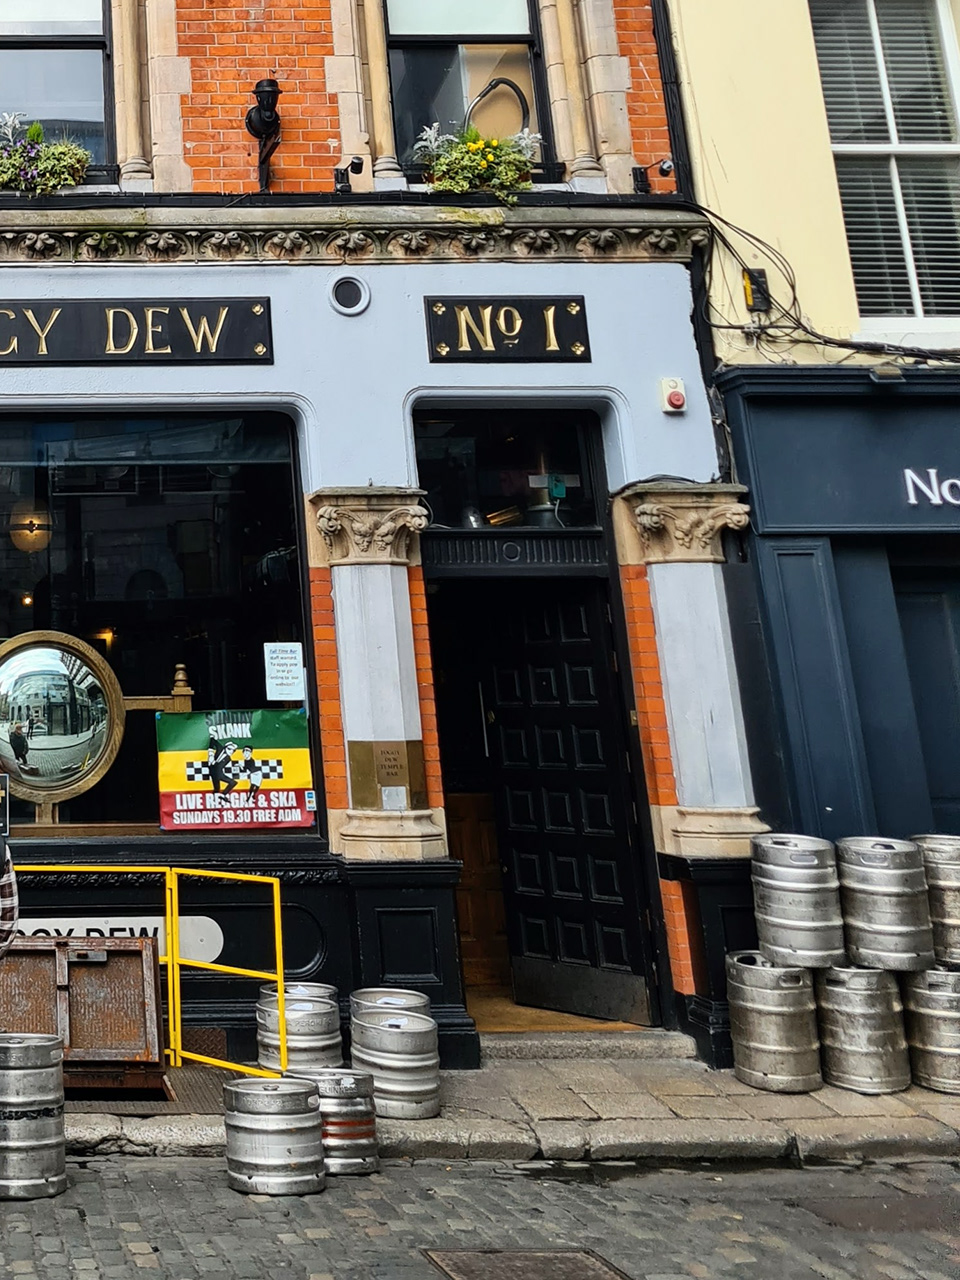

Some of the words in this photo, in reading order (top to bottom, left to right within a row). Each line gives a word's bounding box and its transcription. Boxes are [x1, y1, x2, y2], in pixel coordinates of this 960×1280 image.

[104, 305, 229, 355] DEW
[205, 711, 254, 726] SUNDAY
[208, 723, 252, 740] SKANK
[176, 793, 204, 810] LIVE
[257, 792, 268, 808] &
[270, 791, 297, 807] SKA
[172, 810, 220, 825] SUNDAYS
[222, 809, 250, 823] 19.30
[252, 809, 276, 822] FREE
[278, 809, 302, 822] ADM
